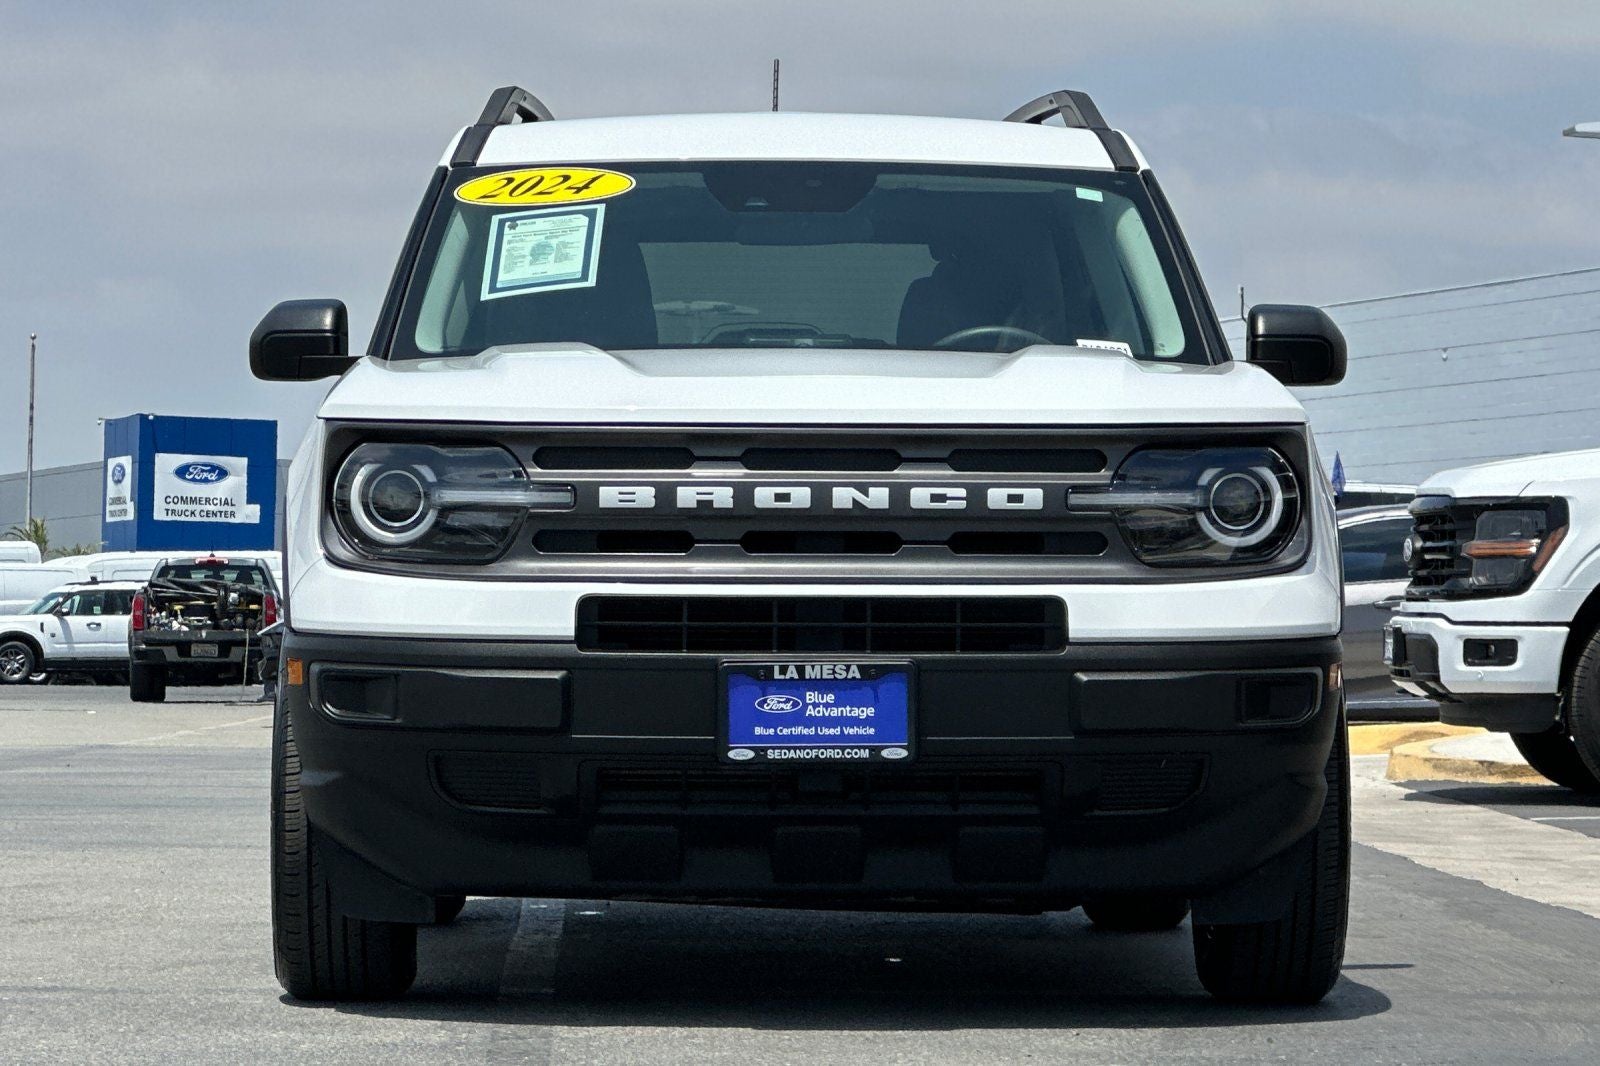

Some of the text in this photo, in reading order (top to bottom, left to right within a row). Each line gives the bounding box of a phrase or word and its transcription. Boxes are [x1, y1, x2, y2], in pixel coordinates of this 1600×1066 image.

[476, 173, 606, 200] 2024
[185, 464, 219, 481] Ford
[164, 495, 236, 507] COMMERCIAL
[599, 486, 1044, 510] BRONCO
[165, 508, 236, 519] TRUCK CENTER
[773, 664, 861, 679] LA MESA
[763, 697, 793, 711] Ford
[805, 691, 835, 704] Blue
[805, 705, 875, 719] Advantage
[754, 726, 875, 735] Blue Certified Used Vehicle
[767, 749, 869, 759] SEDANOFORD.COM
